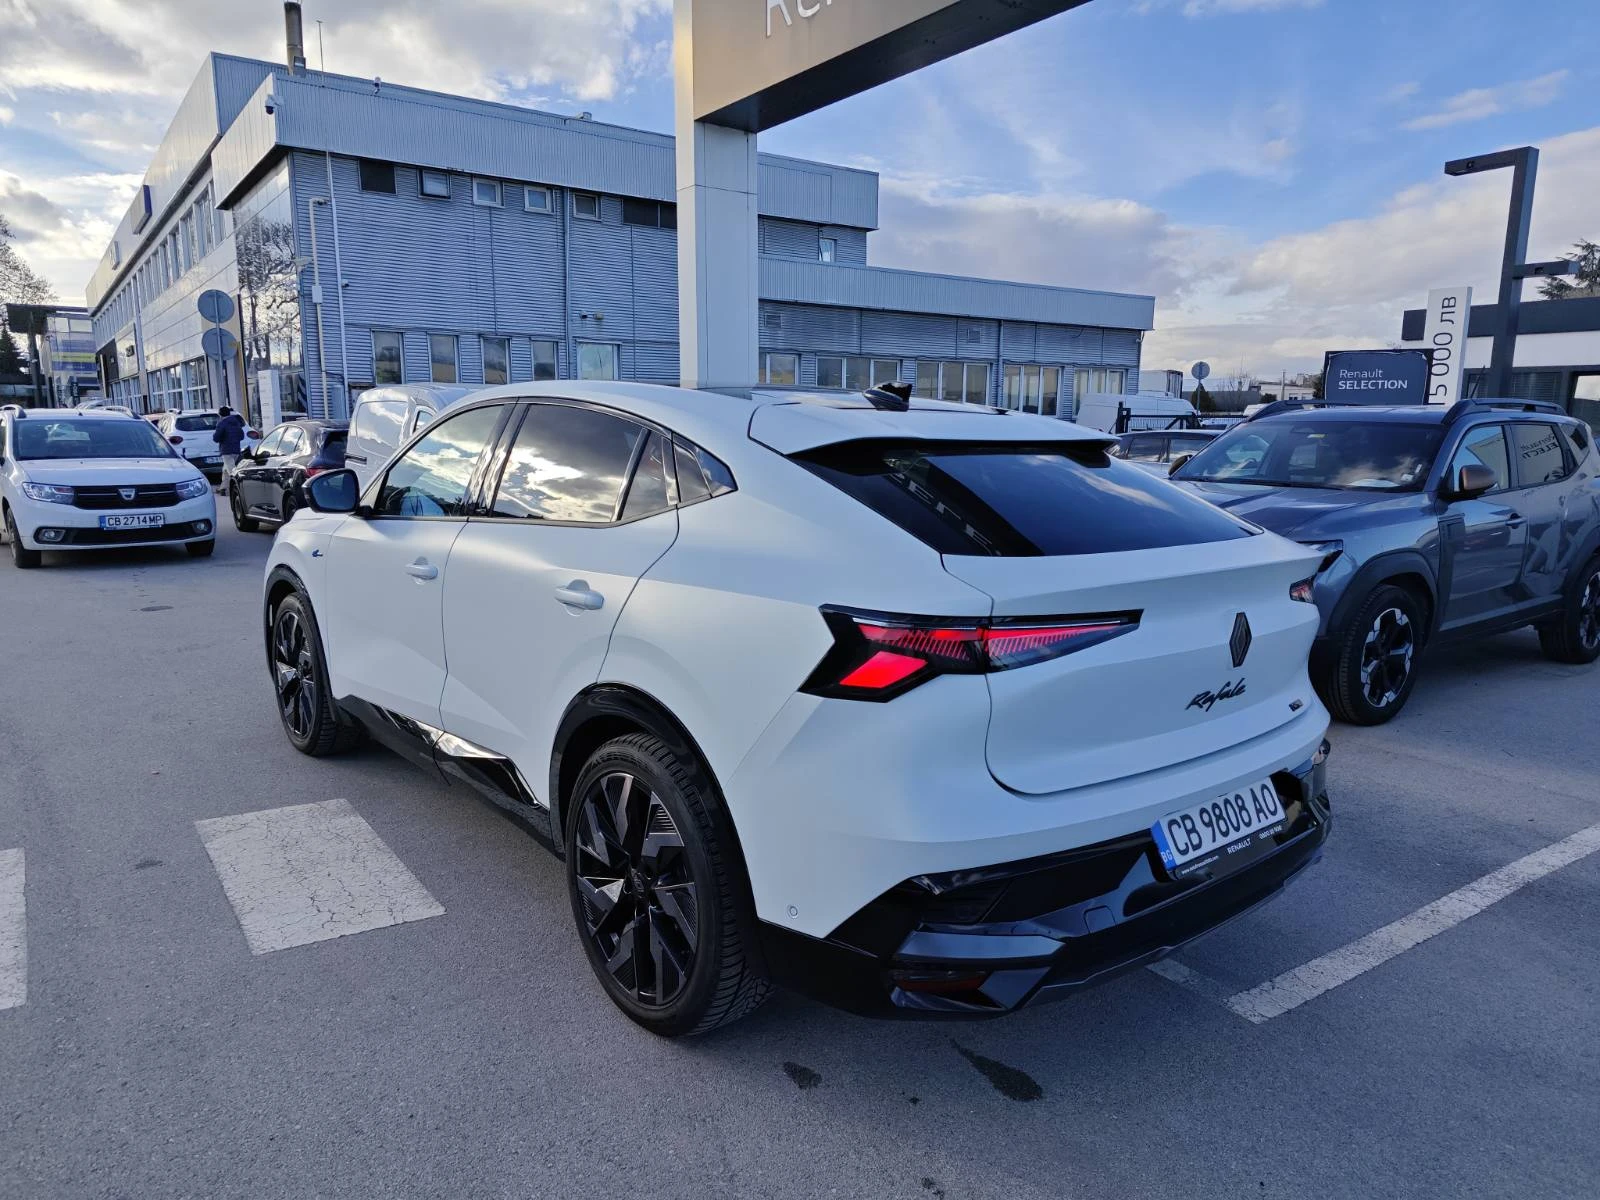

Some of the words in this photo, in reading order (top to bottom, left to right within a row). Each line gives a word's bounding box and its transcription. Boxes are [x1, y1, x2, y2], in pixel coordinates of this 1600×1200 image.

[1440, 296, 1457, 324] лв
[1431, 332, 1453, 377] 000
[1339, 368, 1383, 379] Renault
[1338, 379, 1408, 390] SELECTION
[124, 516, 147, 526] 2714
[1184, 678, 1246, 712] Rafale
[1167, 813, 1203, 856] CB
[1199, 793, 1252, 843] 9808
[1249, 783, 1278, 823] AO
[1226, 837, 1252, 854] RENAULT
[1160, 850, 1174, 863] BG
